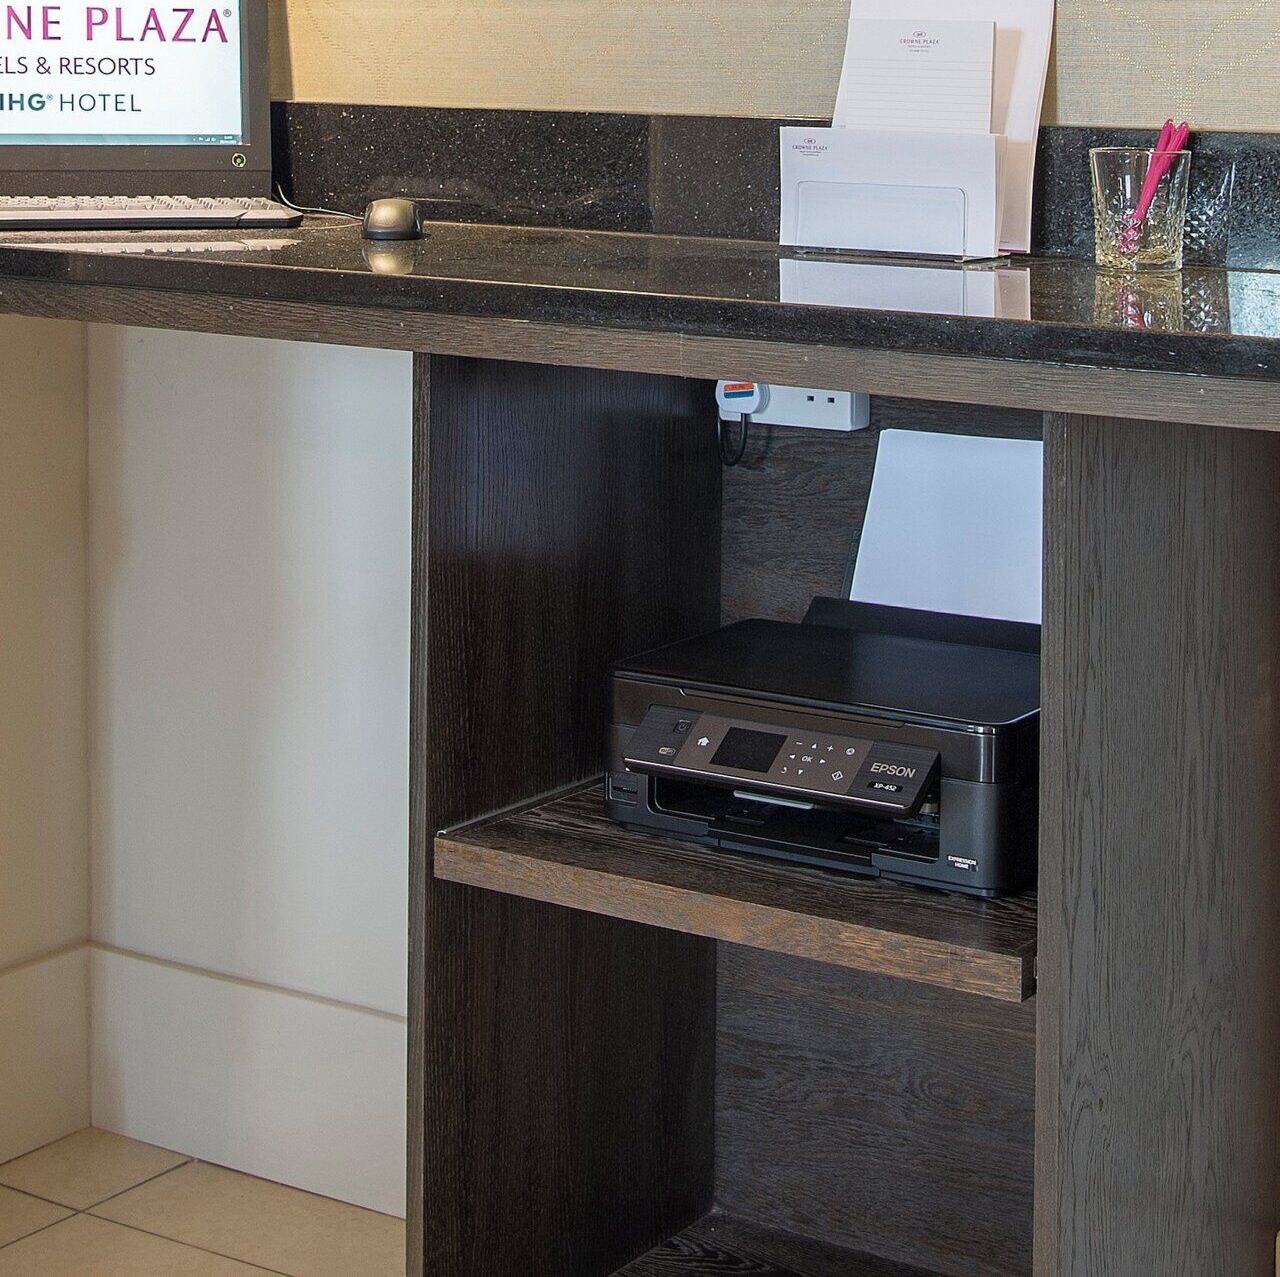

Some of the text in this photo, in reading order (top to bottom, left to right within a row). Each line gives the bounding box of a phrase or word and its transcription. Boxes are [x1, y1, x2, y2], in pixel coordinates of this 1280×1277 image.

[35, 56, 51, 75] &
[59, 57, 156, 77] RESORTS
[59, 93, 142, 113] HOTEL
[801, 755, 814, 763] OK
[870, 762, 916, 778] EPSON
